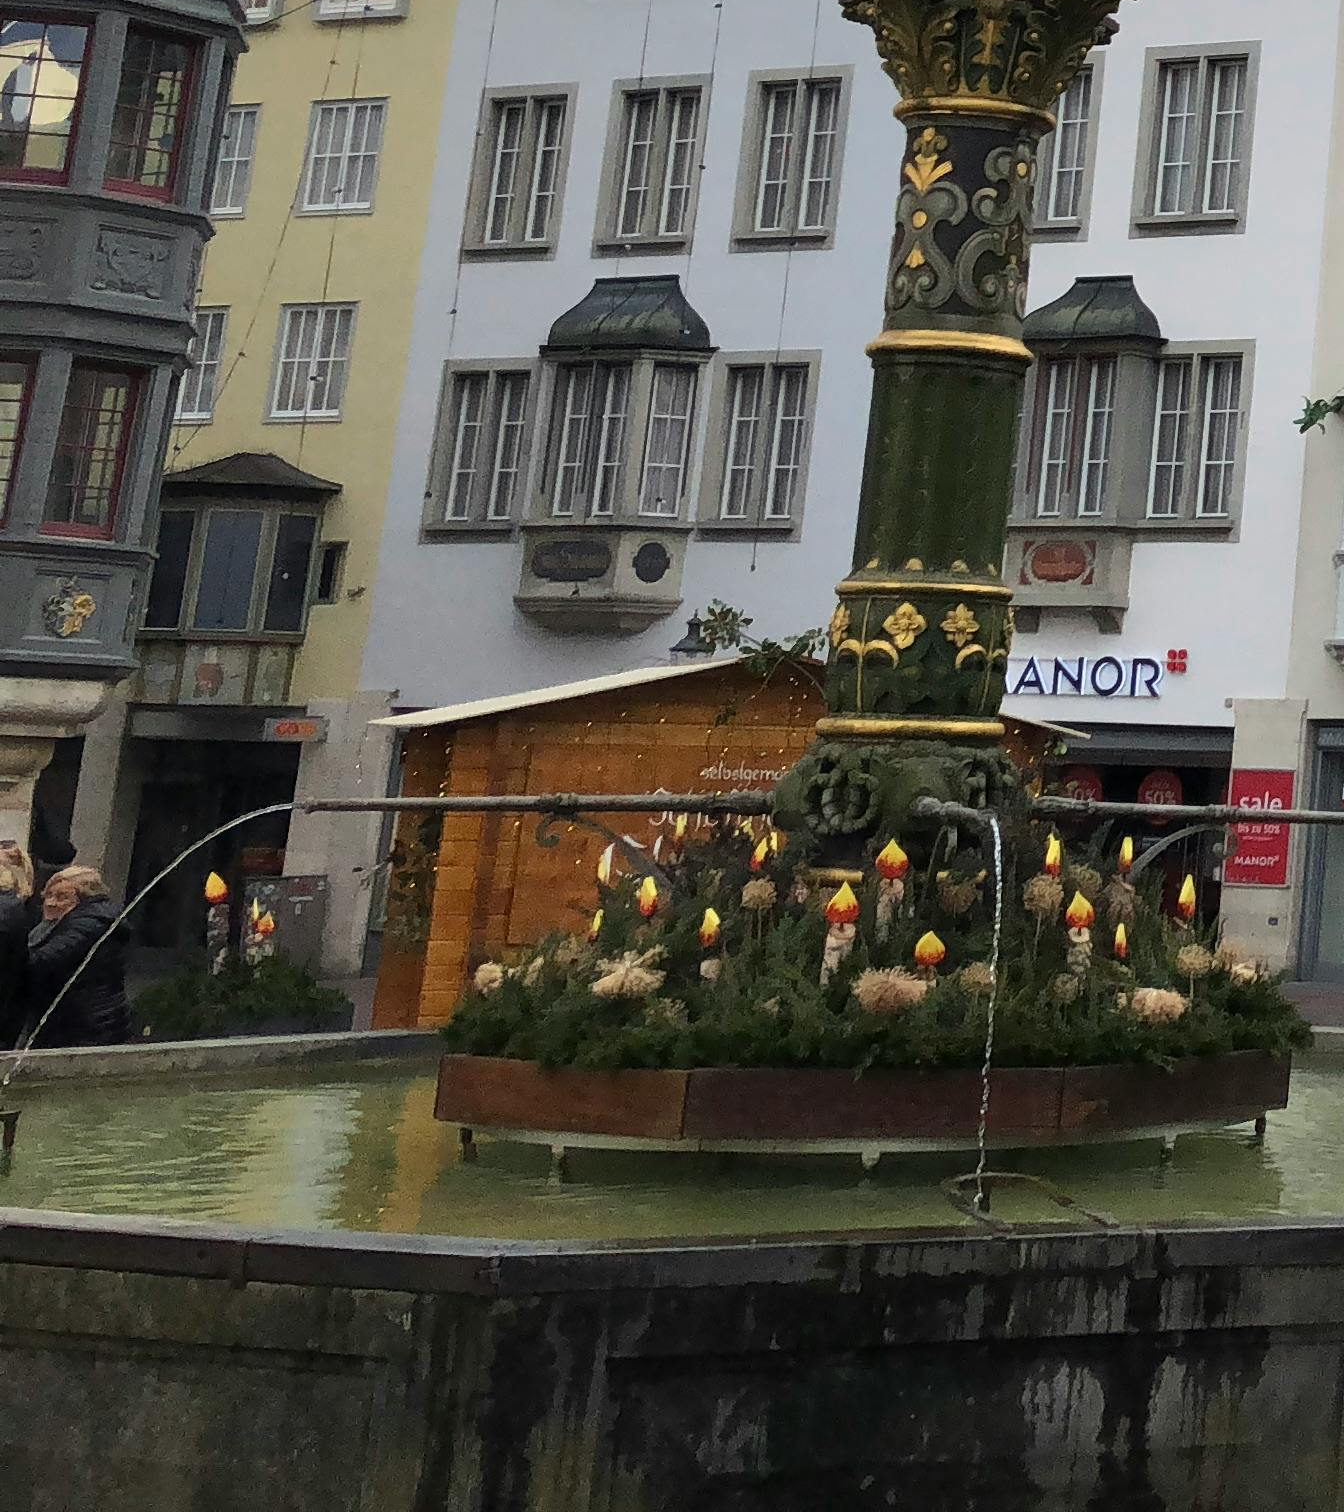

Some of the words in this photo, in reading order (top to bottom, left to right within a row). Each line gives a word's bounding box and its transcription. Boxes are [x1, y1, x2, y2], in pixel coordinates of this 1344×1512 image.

[1003, 655, 1162, 697] ANOR
[1239, 790, 1283, 811] sale
[1263, 824, 1281, 834] 50%
[1233, 855, 1275, 867] MANOR
